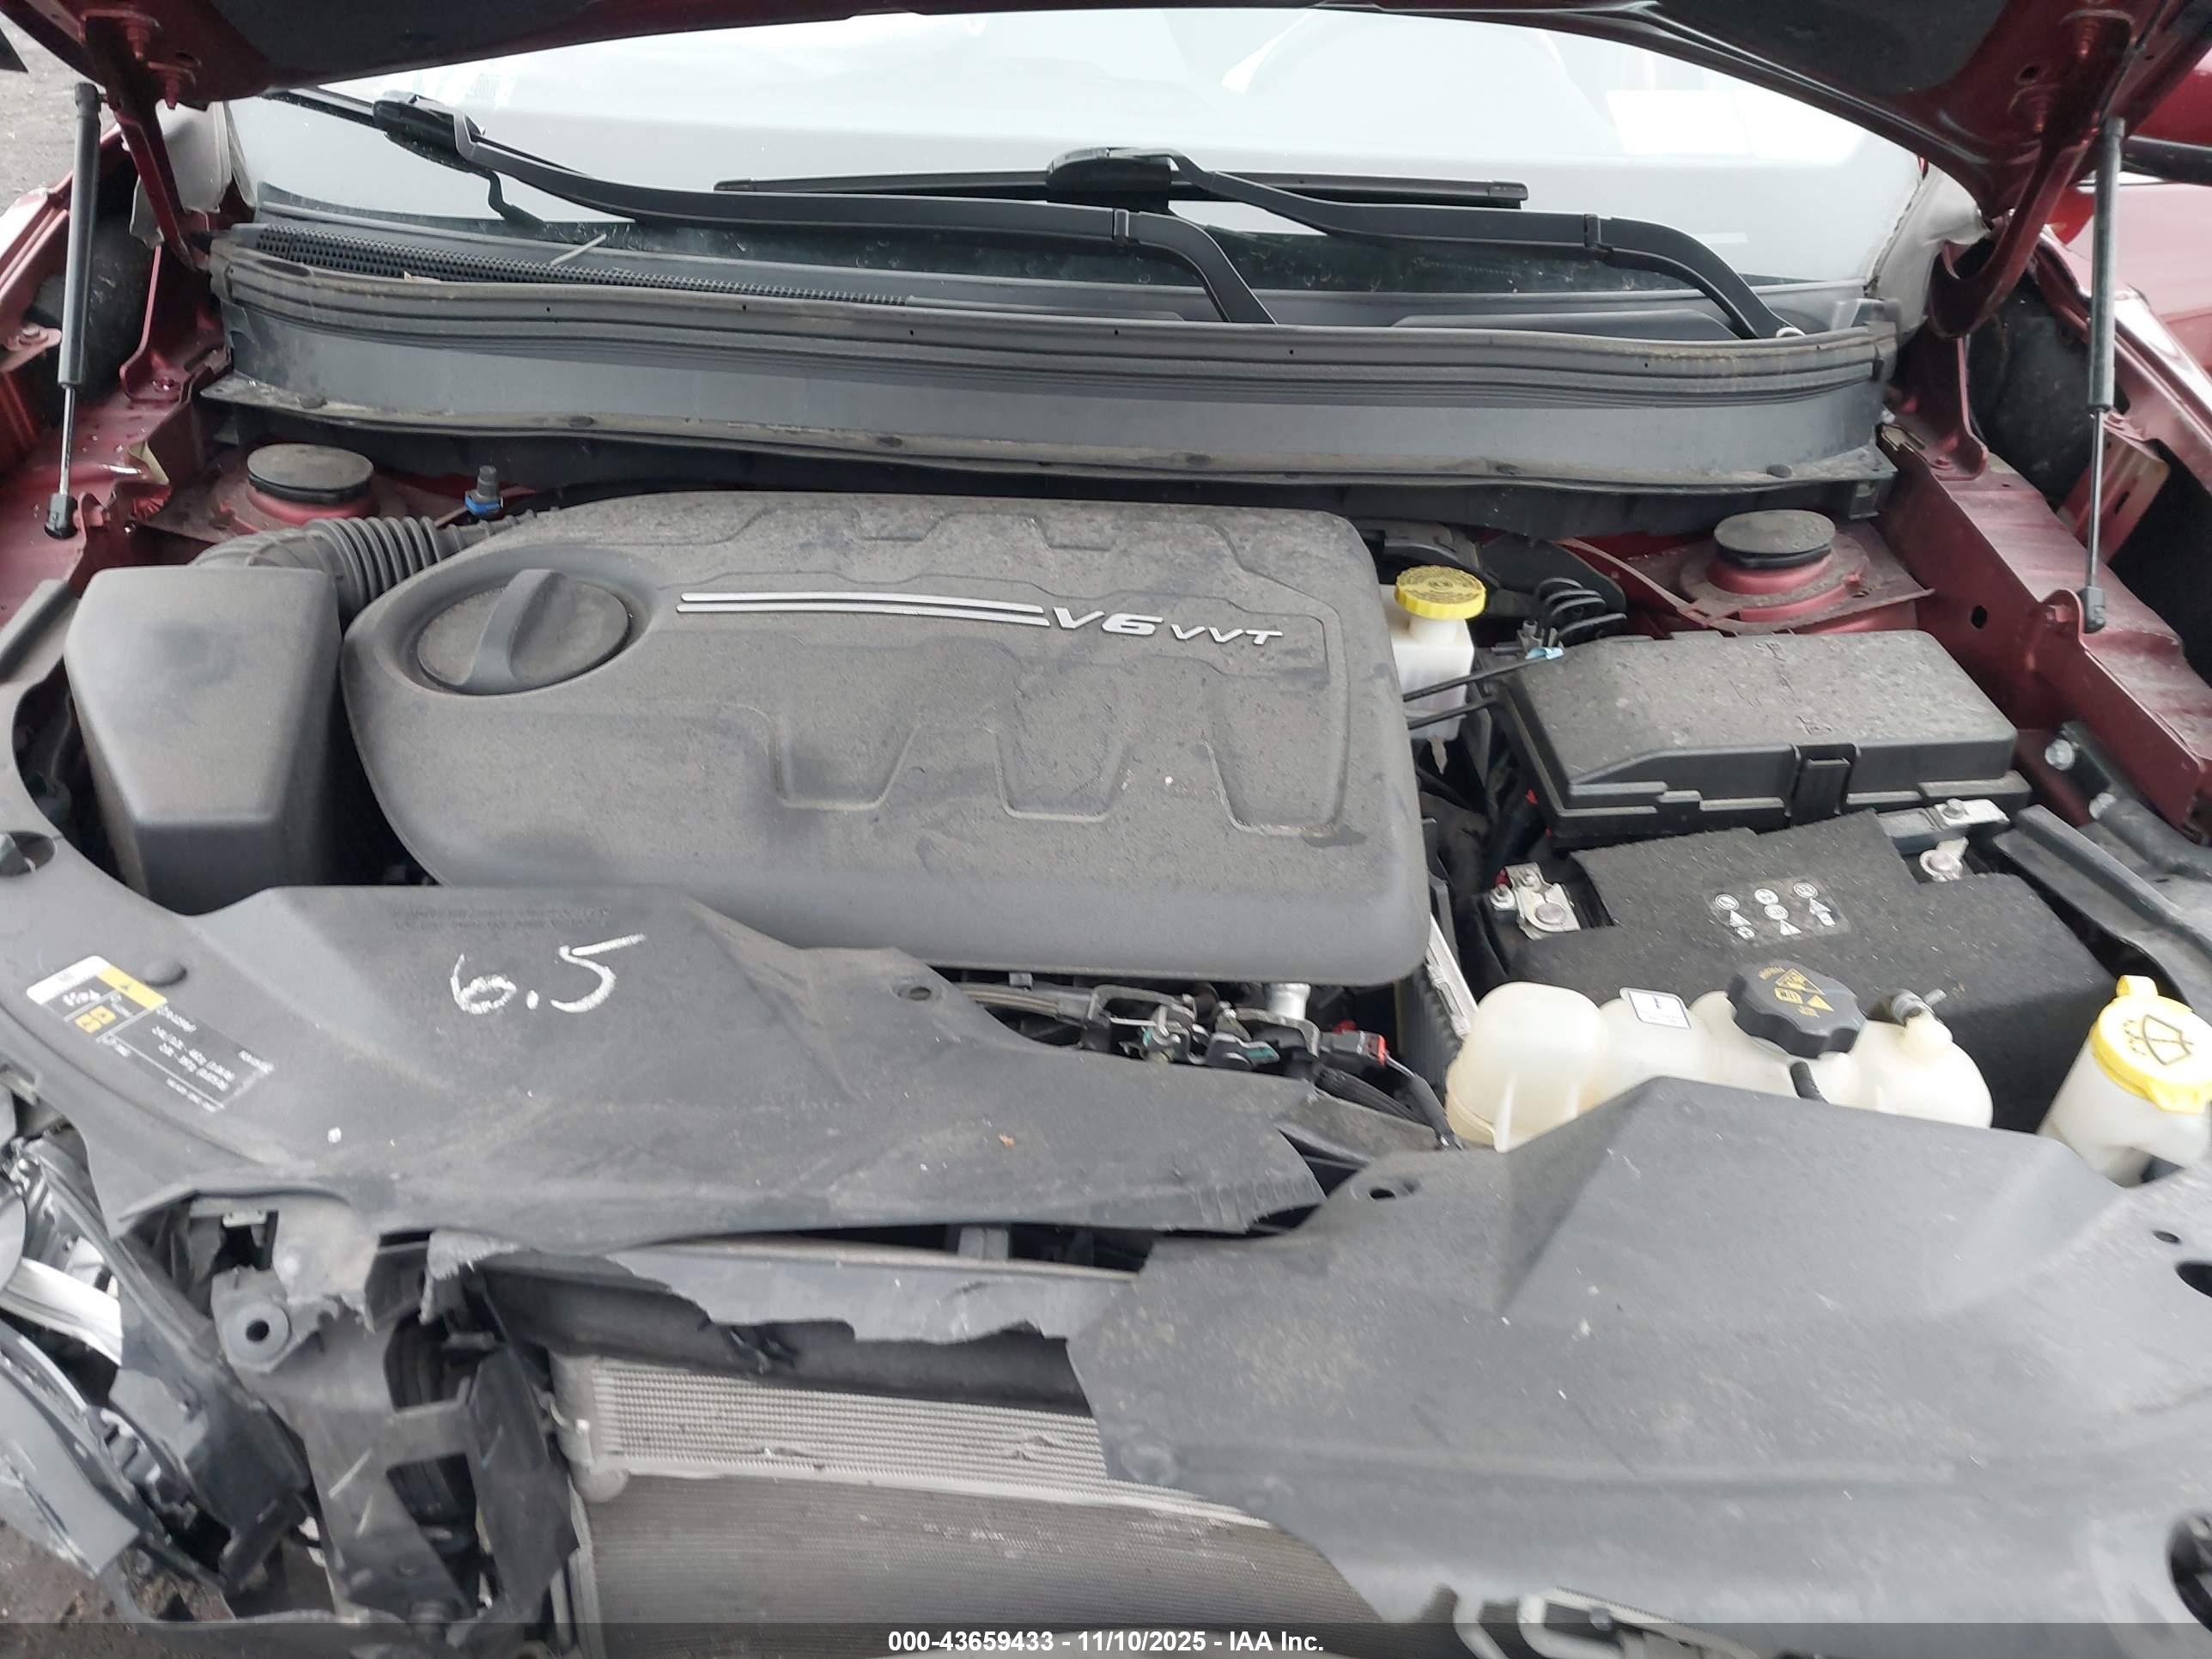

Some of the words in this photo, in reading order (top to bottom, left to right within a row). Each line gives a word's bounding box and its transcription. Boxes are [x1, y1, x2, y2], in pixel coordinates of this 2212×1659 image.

[1052, 606, 1164, 635] V6
[1170, 623, 1284, 646] VVT
[449, 933, 646, 1015] 6.5
